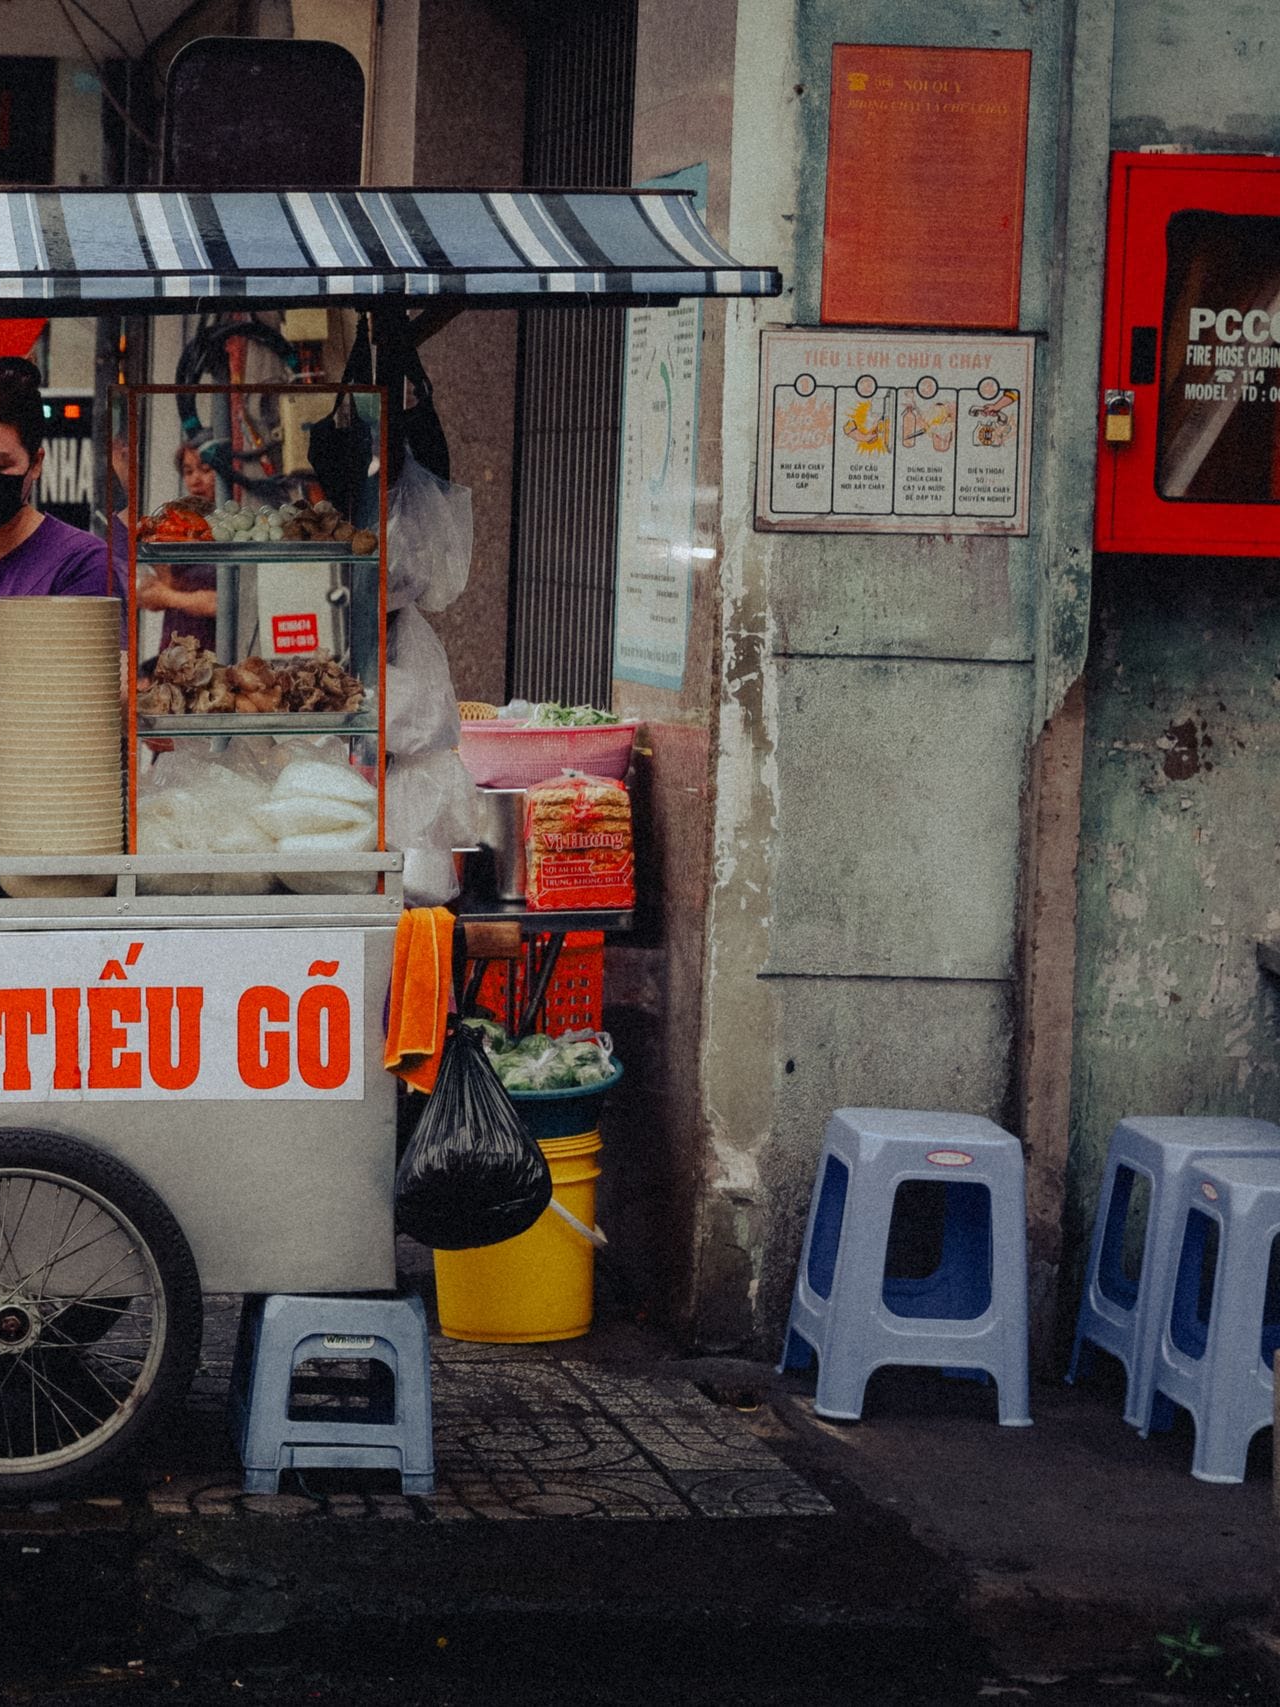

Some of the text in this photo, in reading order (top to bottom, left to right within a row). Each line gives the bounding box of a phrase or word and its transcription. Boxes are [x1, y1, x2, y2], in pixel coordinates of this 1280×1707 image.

[1186, 345, 1213, 366] FIRE
[1215, 346, 1245, 368] HOSE
[1242, 370, 1265, 384] 114
[1184, 384, 1228, 402] MODEL
[1241, 385, 1258, 402] TD
[542, 832, 624, 852] Vị Hương
[236, 958, 352, 1091] GÕ
